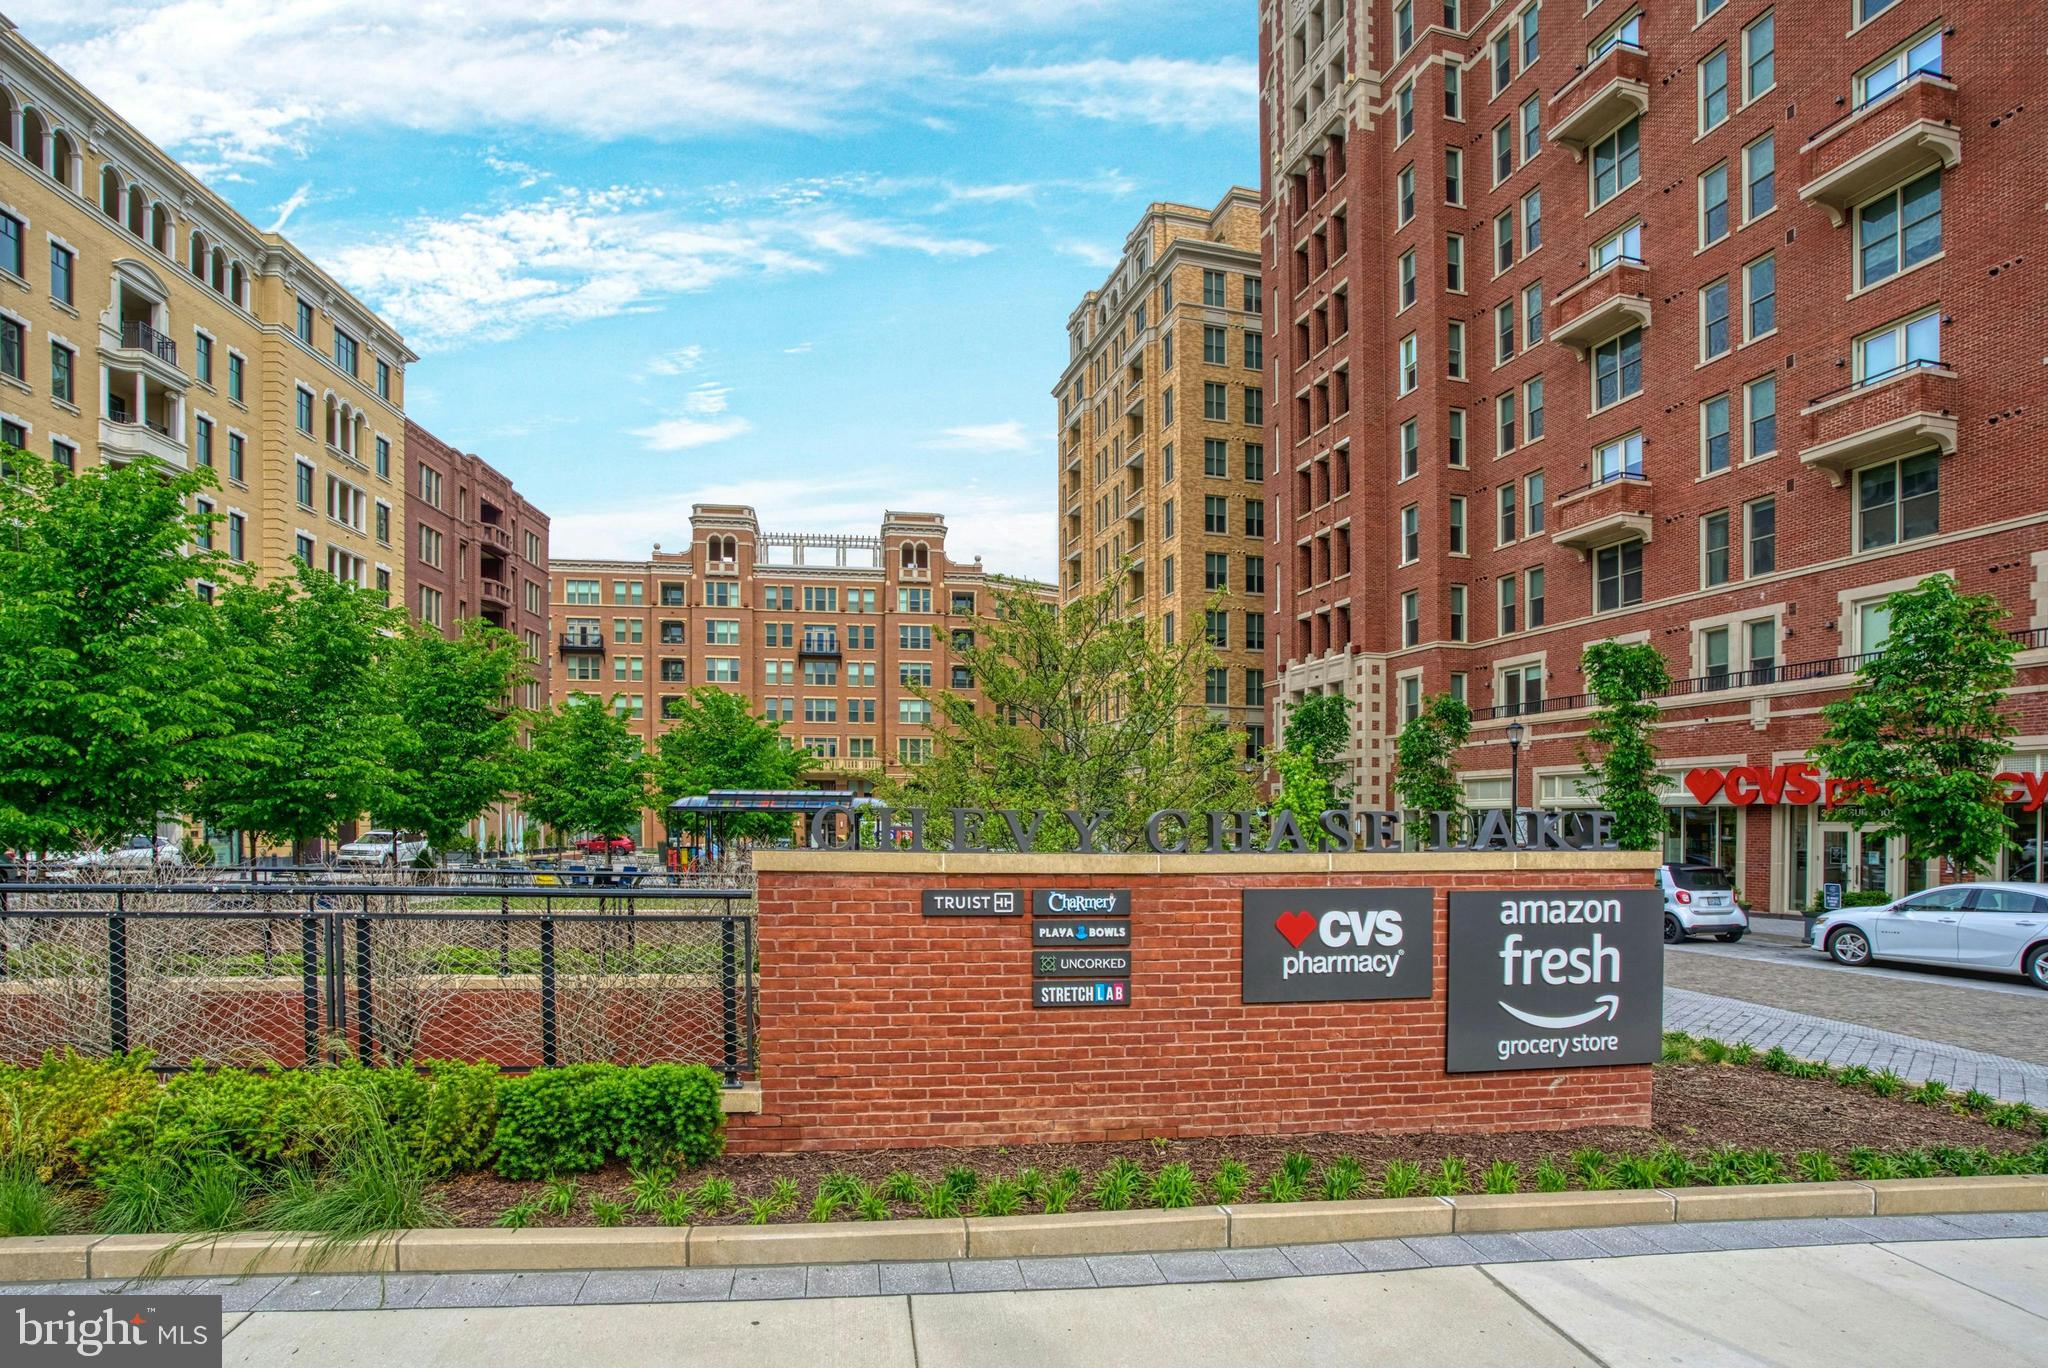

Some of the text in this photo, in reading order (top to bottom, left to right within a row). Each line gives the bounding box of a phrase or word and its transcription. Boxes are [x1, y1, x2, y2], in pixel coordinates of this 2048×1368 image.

[1724, 763, 1821, 806] CVS
[811, 805, 1620, 853] CHEVY CHASE LAKE
[934, 896, 991, 909] TRUIST
[1500, 899, 1621, 925] amazon
[1039, 927, 1126, 937] PLAYA BOWLS
[1318, 909, 1403, 948] CVS
[1060, 959, 1126, 969] UNCORKED
[1499, 933, 1620, 985] fresh
[1498, 1034, 1618, 1061] grocery store
